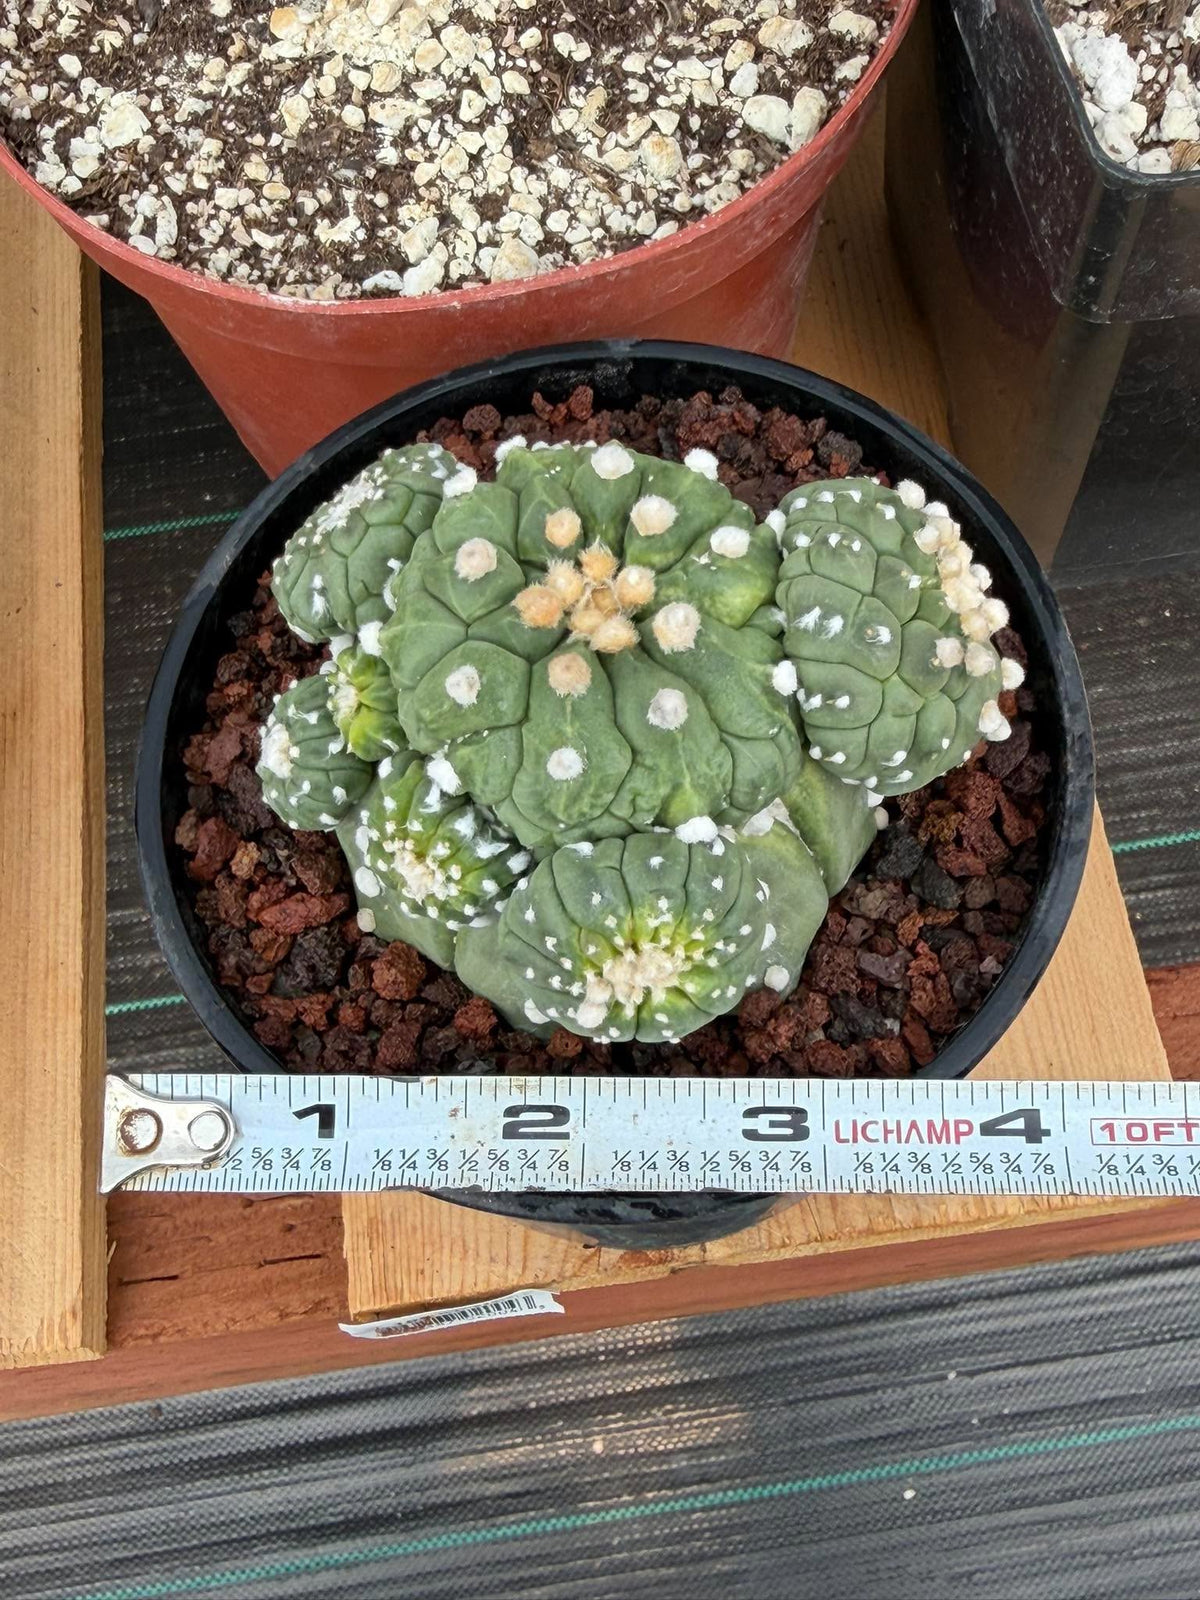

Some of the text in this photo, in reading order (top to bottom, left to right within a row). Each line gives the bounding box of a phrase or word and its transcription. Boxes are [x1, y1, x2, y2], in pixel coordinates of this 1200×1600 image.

[292, 1104, 1200, 1145] 1 2 3 LICHAMP 4 10FT
